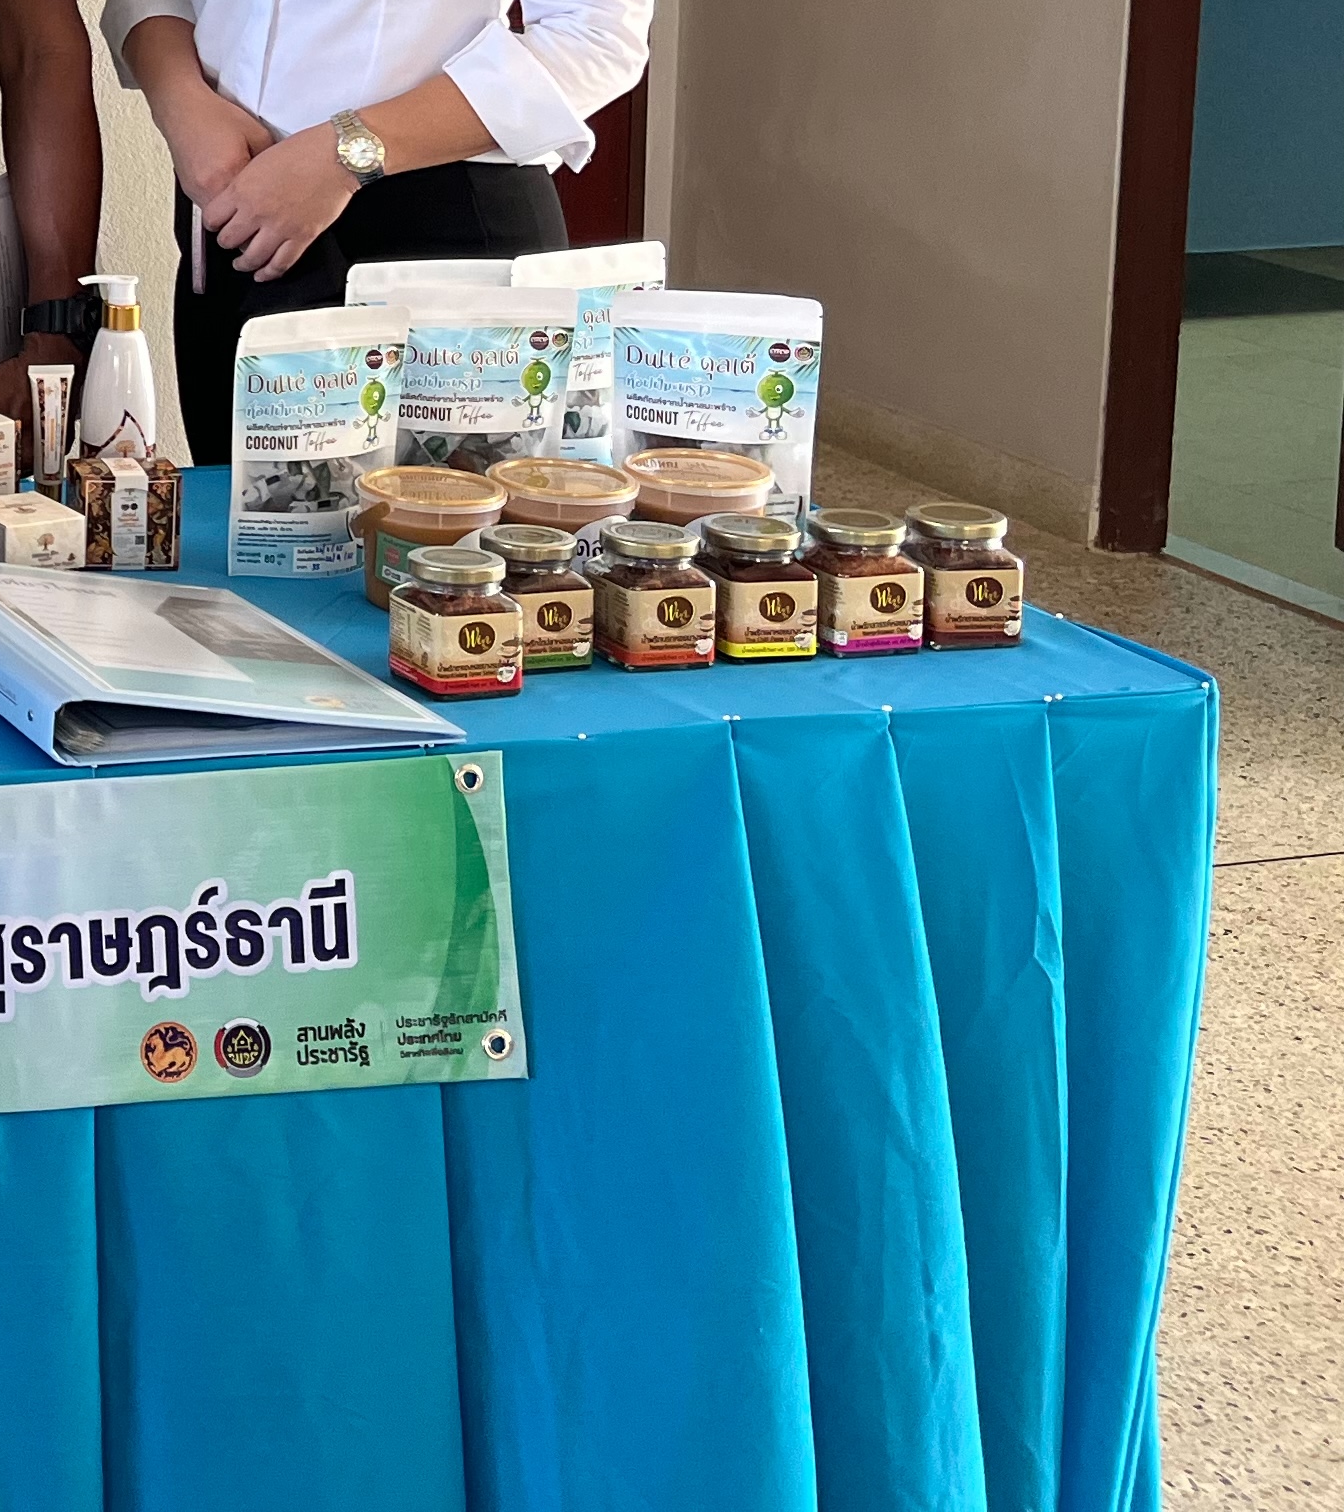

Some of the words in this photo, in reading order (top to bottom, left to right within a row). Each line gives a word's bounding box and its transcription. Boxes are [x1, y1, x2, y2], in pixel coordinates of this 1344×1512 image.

[399, 404, 452, 422] COCONUT
[626, 404, 679, 426] COCONUT
[245, 435, 299, 451] COCONUT
[297, 1016, 366, 1043] สานพลัง
[395, 1009, 508, 1029] ประชารัฐรักสามัคคี
[297, 1041, 371, 1067] ประชารัฐ
